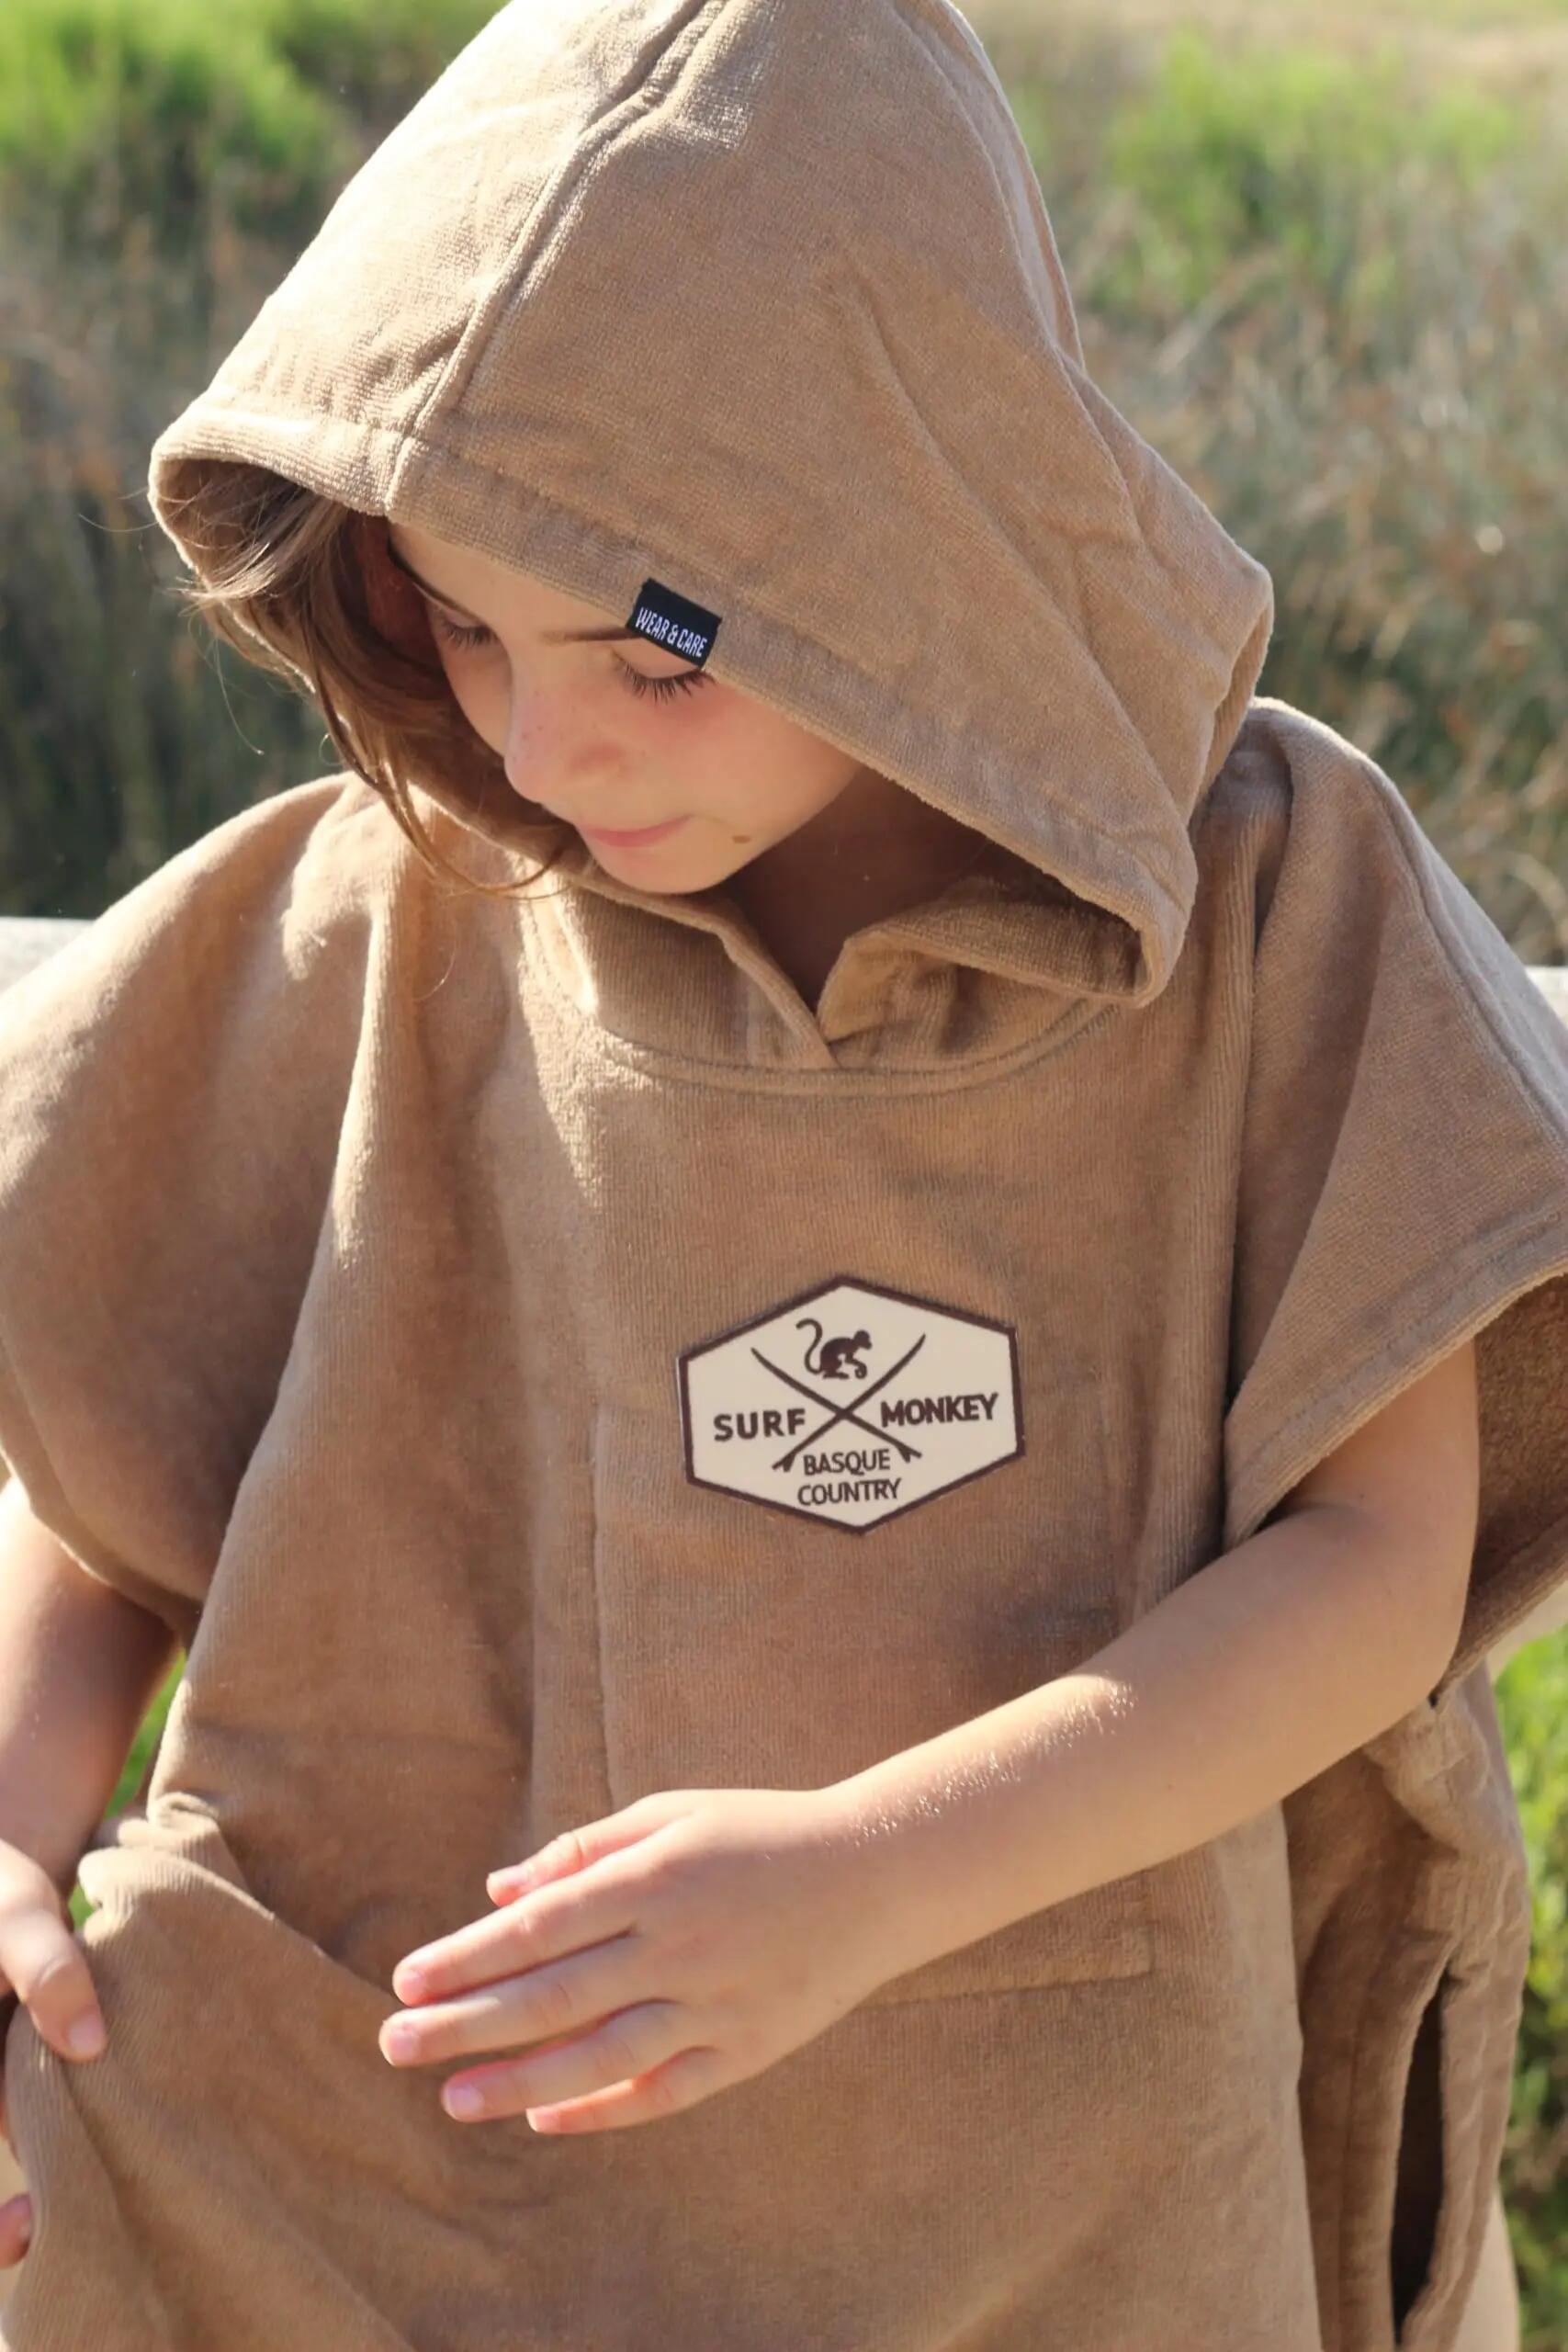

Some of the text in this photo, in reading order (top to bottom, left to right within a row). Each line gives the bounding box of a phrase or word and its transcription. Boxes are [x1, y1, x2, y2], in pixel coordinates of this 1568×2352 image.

[635, 607, 708, 658] WEAR & CARE
[713, 1392, 998, 1442] SURF MONKEY
[803, 1449, 891, 1476] BASQUE
[797, 1477, 902, 1506] COUNTRY
